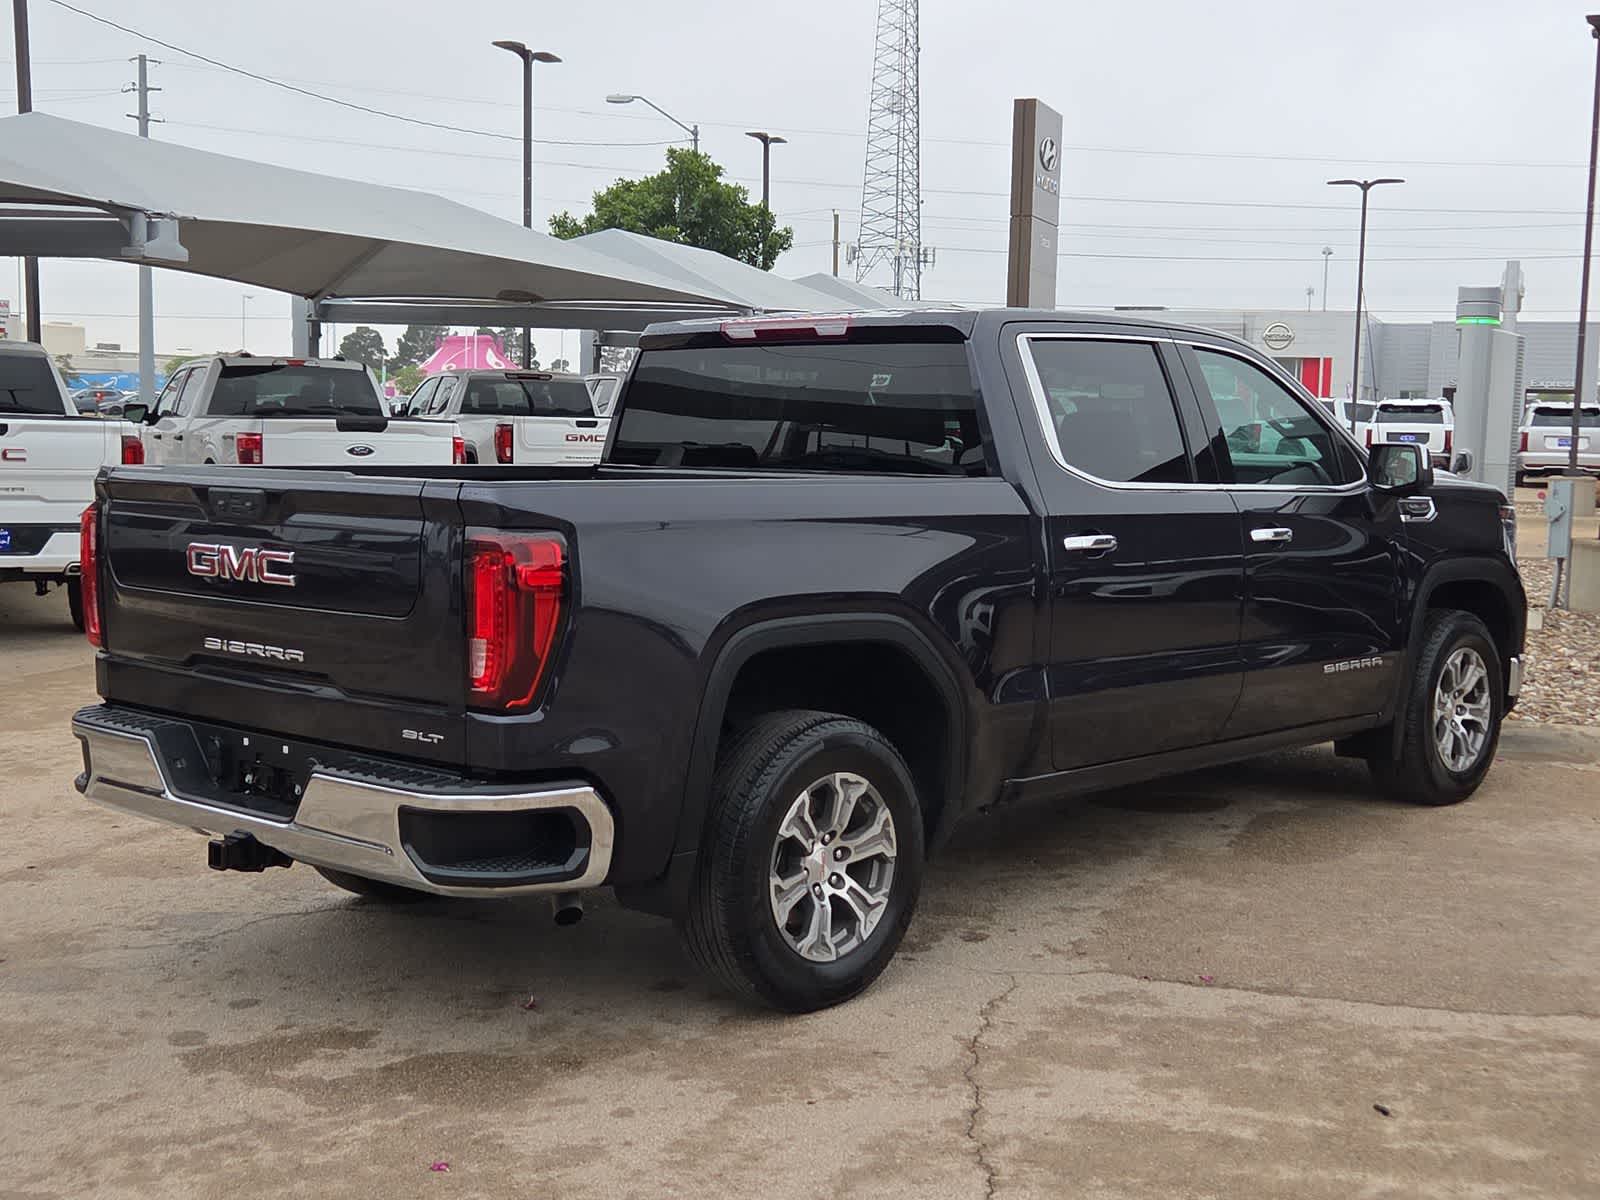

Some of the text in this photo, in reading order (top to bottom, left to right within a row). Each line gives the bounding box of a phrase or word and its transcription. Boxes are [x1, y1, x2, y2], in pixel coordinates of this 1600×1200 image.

[565, 433, 606, 442] GMC
[186, 542, 296, 587] GMC
[203, 637, 304, 663] SIERRA
[1323, 656, 1383, 674] SIERRA
[401, 729, 444, 744] SLT
